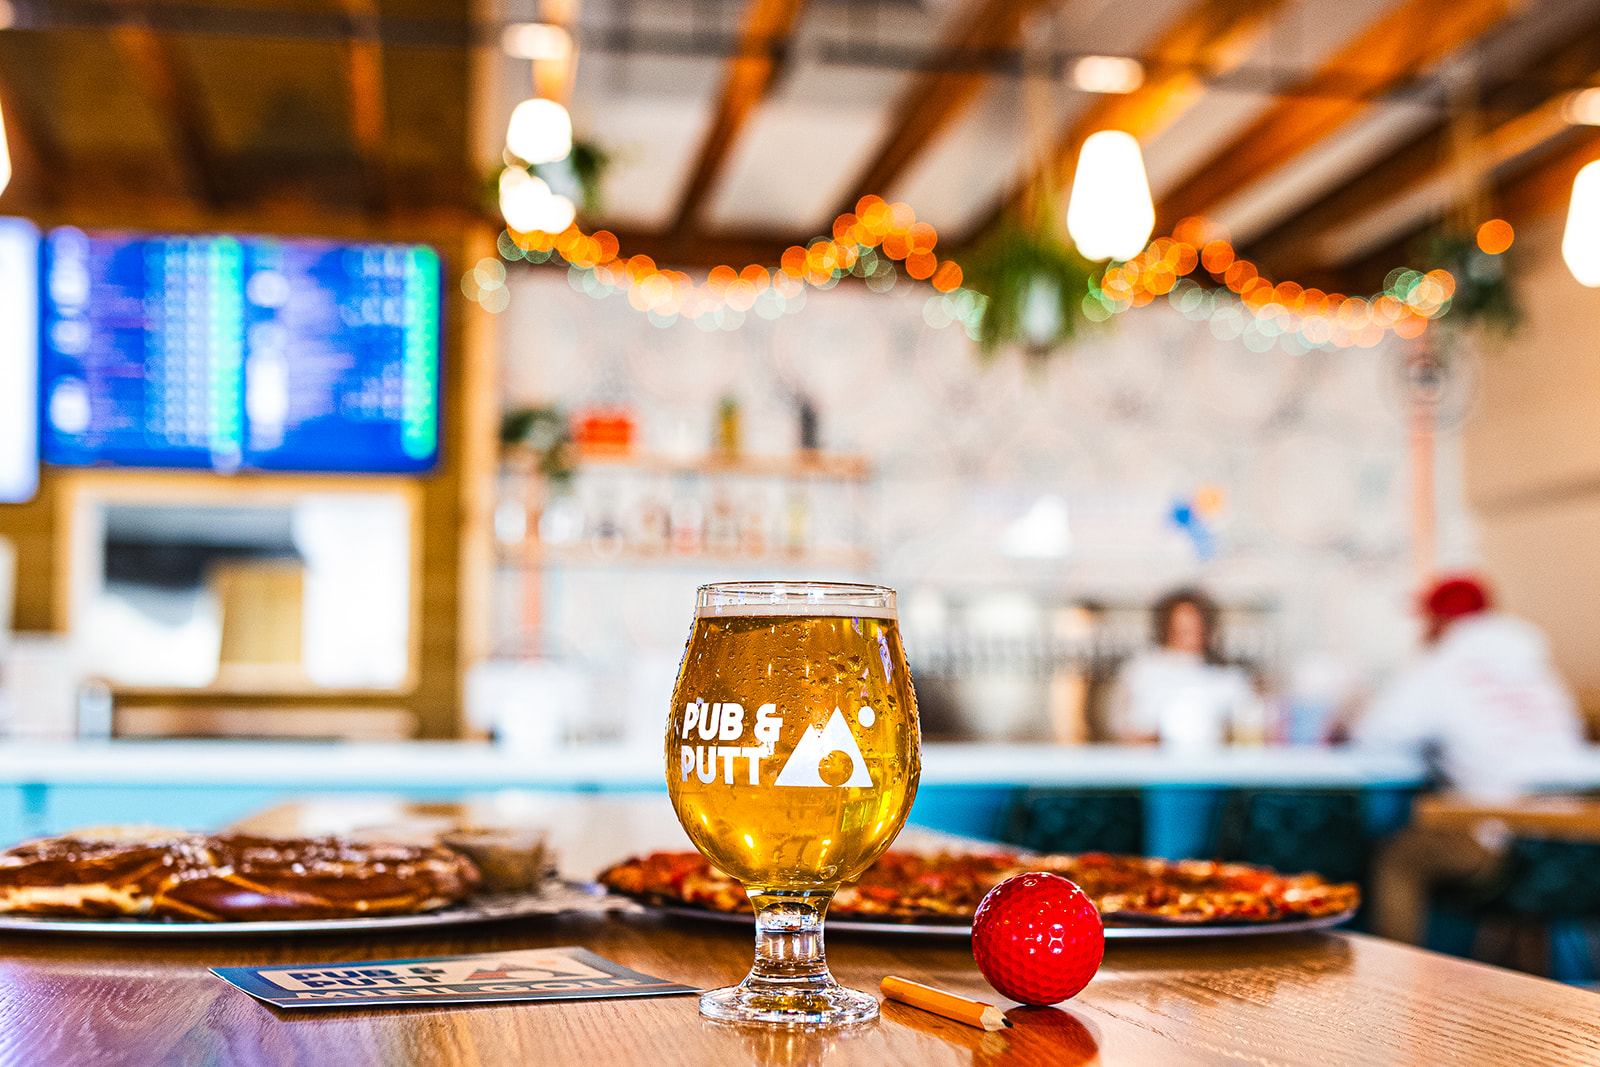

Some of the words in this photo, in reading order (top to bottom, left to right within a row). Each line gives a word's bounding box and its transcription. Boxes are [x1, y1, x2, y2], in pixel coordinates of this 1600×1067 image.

[681, 702, 744, 741] PUB
[754, 703, 783, 742] &
[681, 745, 767, 786] PUTT
[288, 969, 397, 981] PUB
[408, 966, 446, 978] &
[301, 975, 442, 989] PUTT
[295, 986, 461, 999] MINI
[478, 978, 642, 993] GOLF
